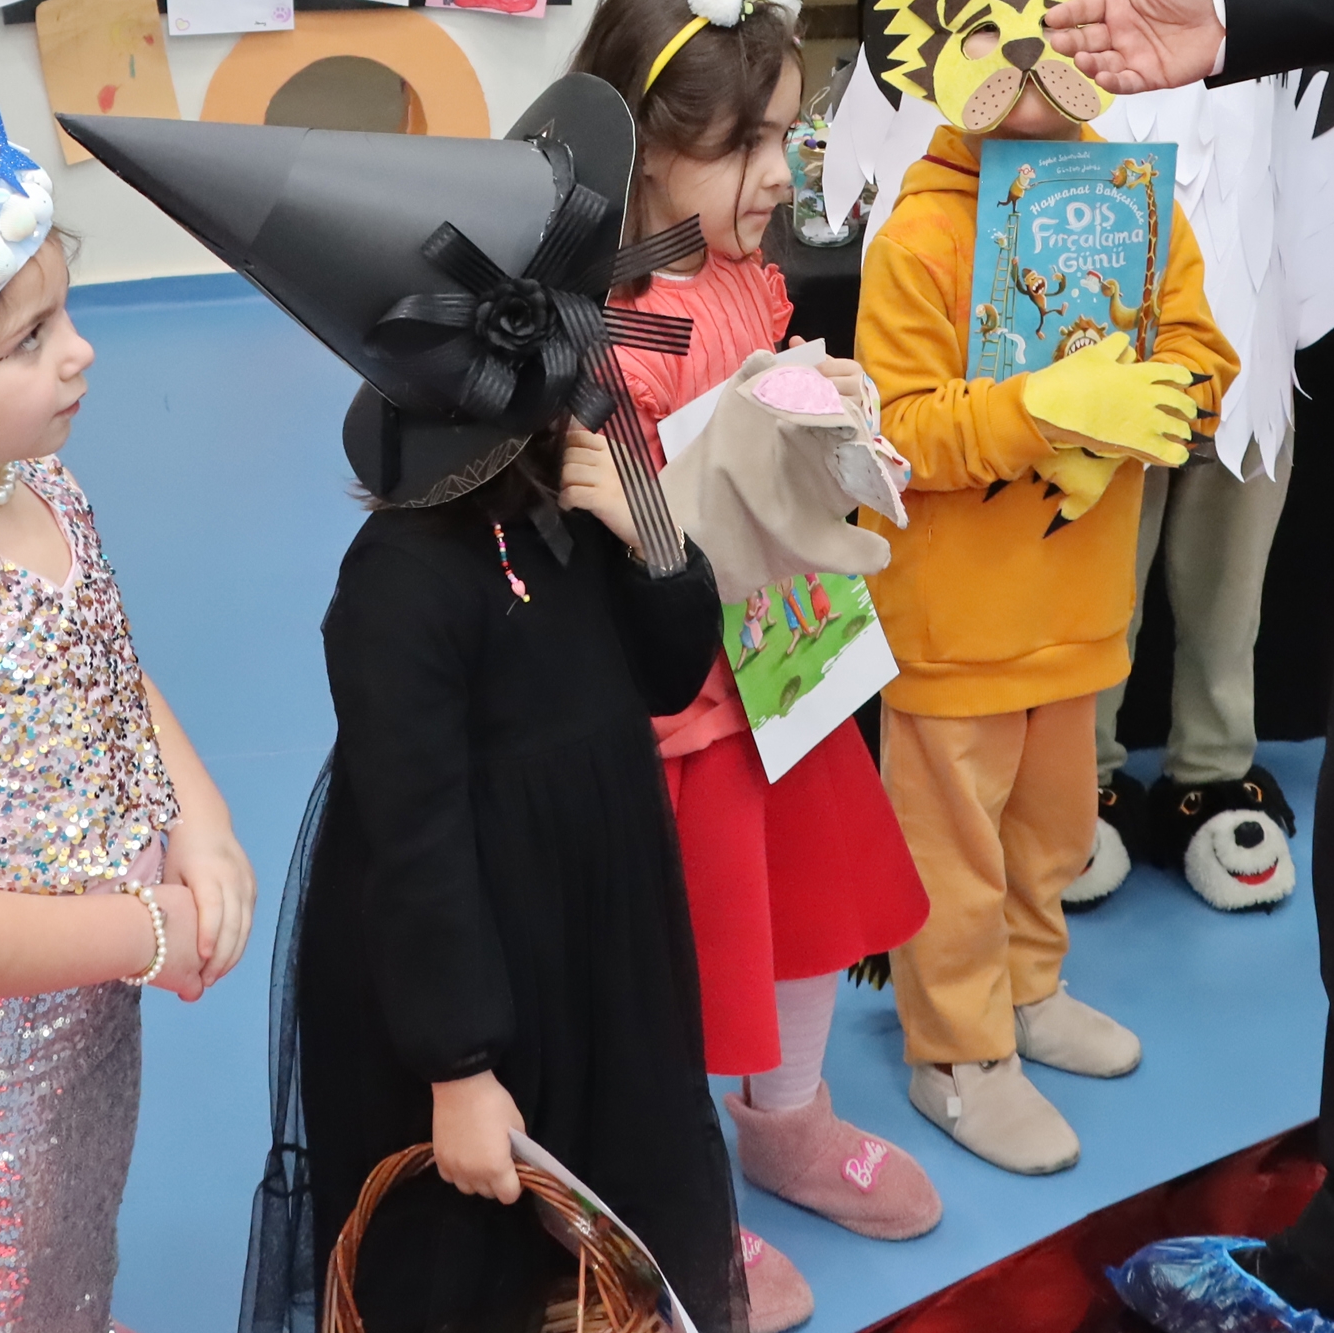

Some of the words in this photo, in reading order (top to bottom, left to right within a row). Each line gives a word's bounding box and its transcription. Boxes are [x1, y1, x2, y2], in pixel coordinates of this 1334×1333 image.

[1030, 186, 1090, 215] Hayvanat
[1095, 183, 1145, 225] Bahçesinde
[1032, 217, 1144, 254] Fırçalama
[1058, 247, 1127, 273] Günü
[846, 1141, 888, 1188] Barbie
